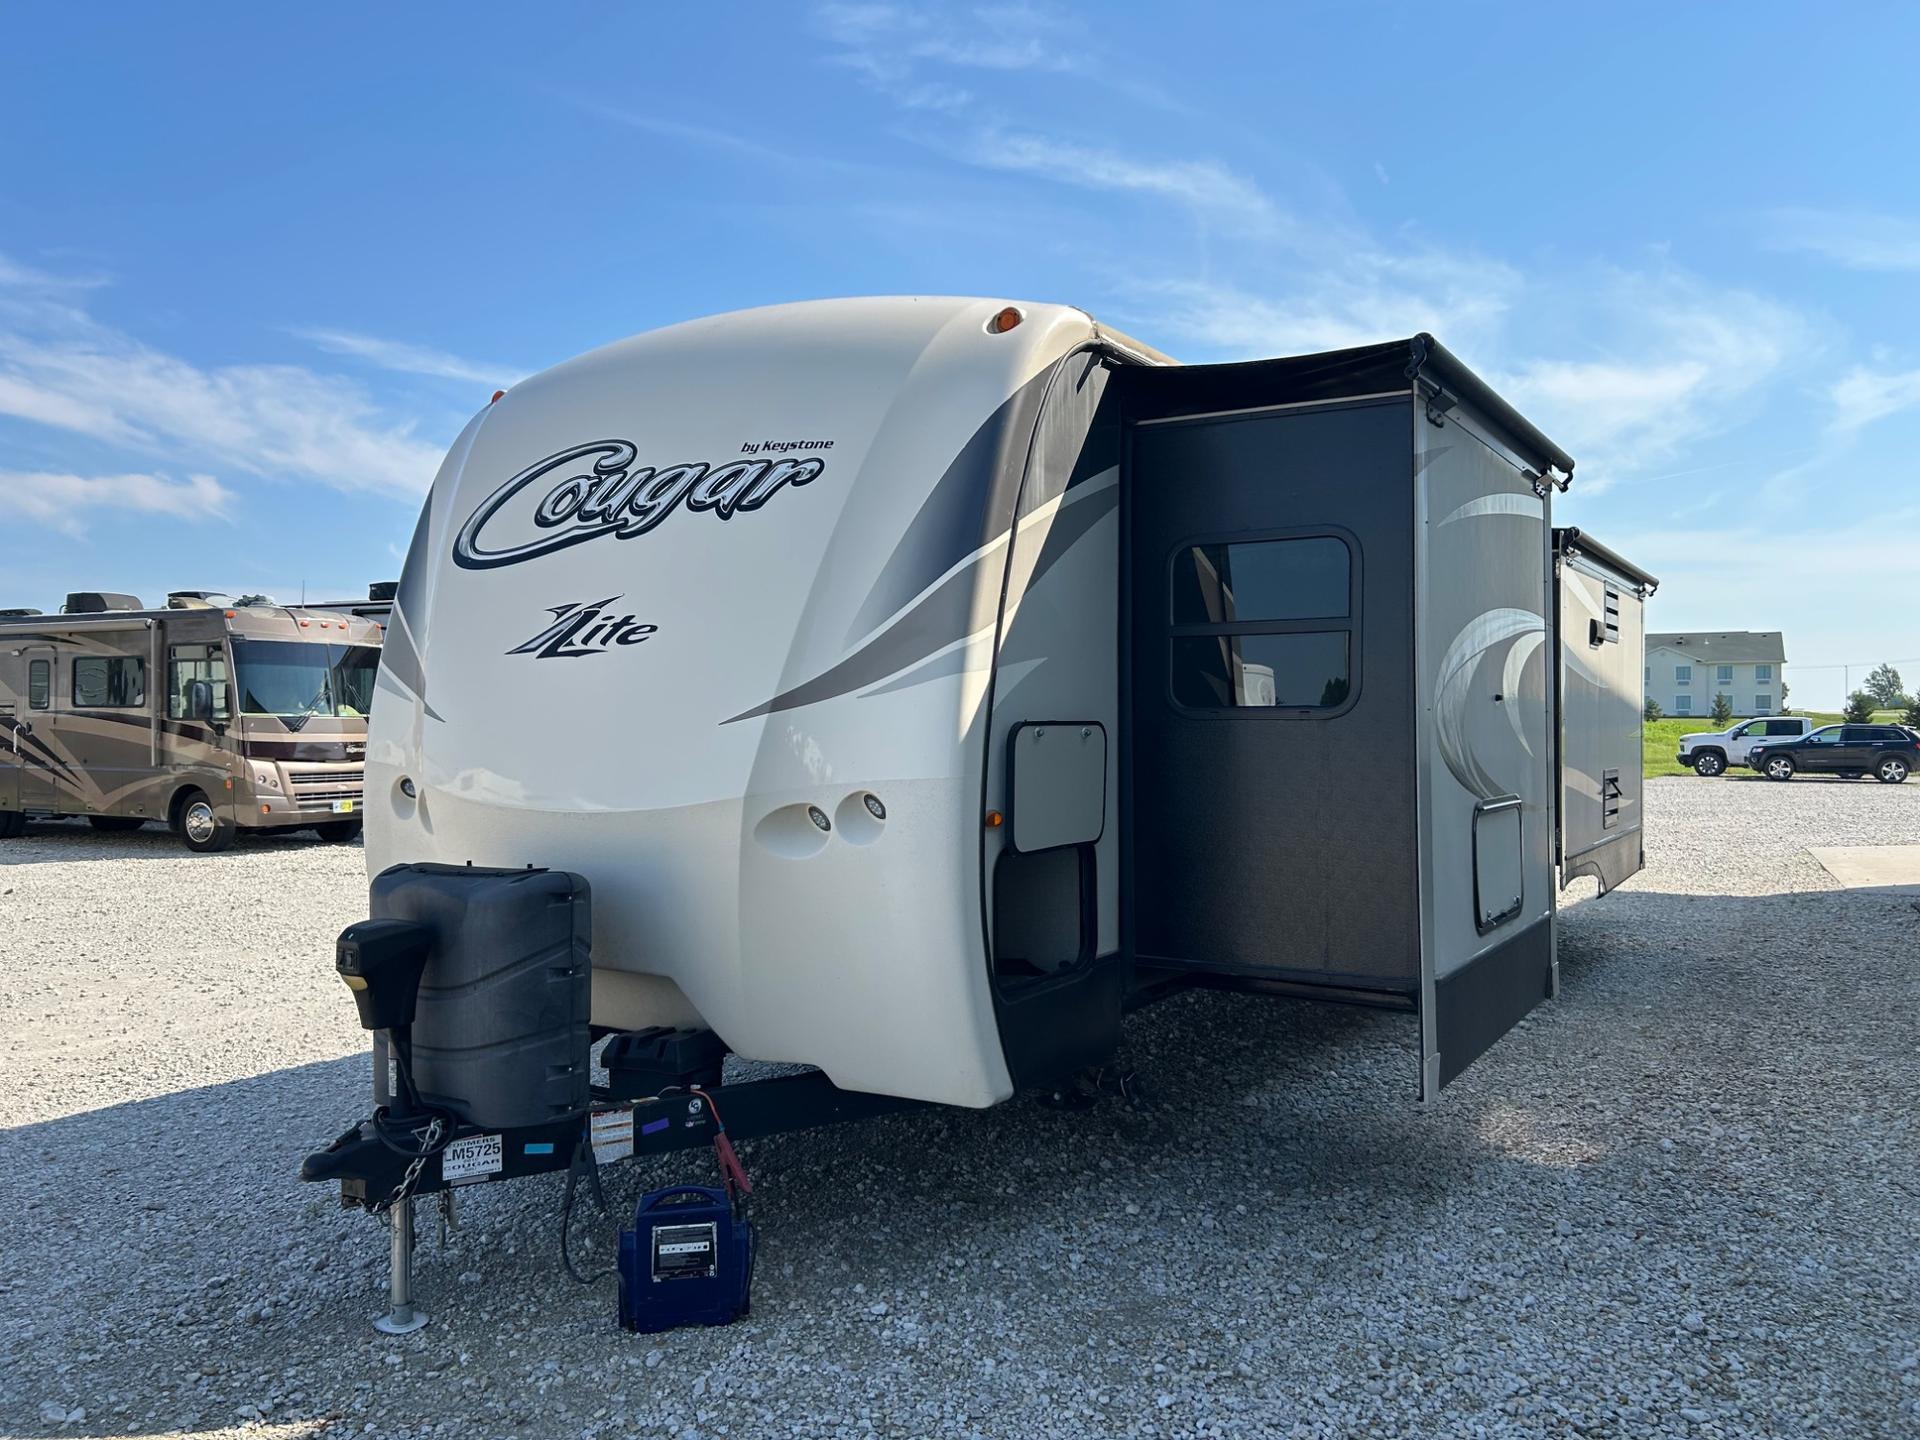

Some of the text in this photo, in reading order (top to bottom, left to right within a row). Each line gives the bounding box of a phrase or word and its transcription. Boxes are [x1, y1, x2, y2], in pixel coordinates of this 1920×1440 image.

[741, 440, 834, 455] by Keystone
[452, 438, 825, 569] Cougar
[444, 1158, 500, 1171] COUGAR
